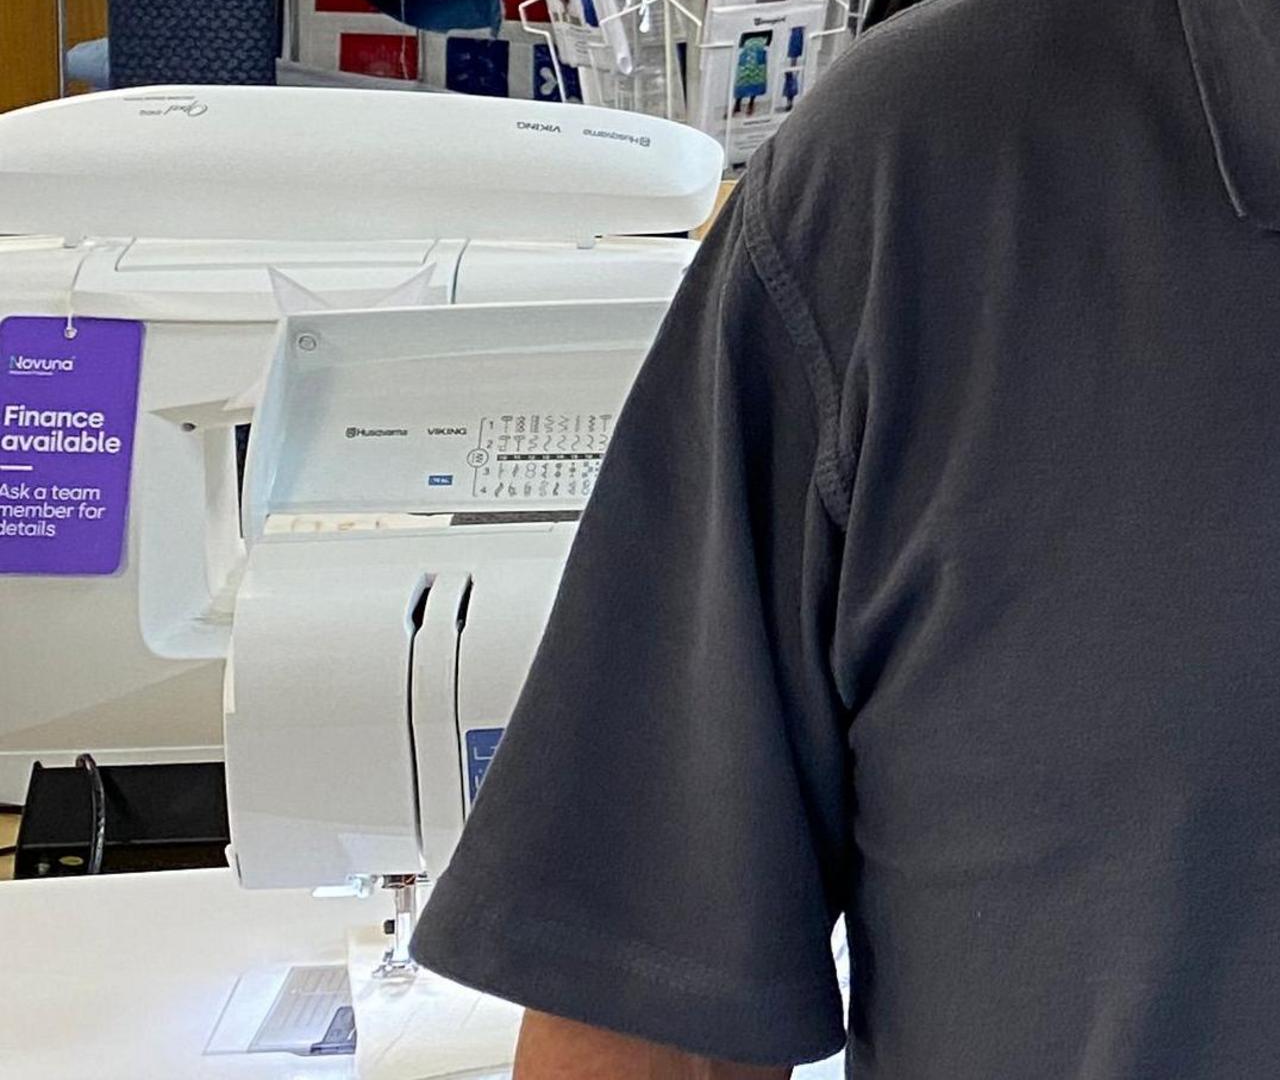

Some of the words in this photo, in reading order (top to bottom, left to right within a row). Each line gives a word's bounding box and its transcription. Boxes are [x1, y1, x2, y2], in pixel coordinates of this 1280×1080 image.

[517, 121, 561, 133] VIKING
[9, 356, 73, 370] Novuna
[4, 405, 105, 428] Finance
[356, 427, 408, 438] Husqvarna
[428, 427, 467, 436] VIKING
[1, 431, 121, 453] available
[0, 483, 30, 500] Ask
[34, 487, 46, 500] a
[51, 485, 100, 501] team
[79, 502, 105, 519] for
